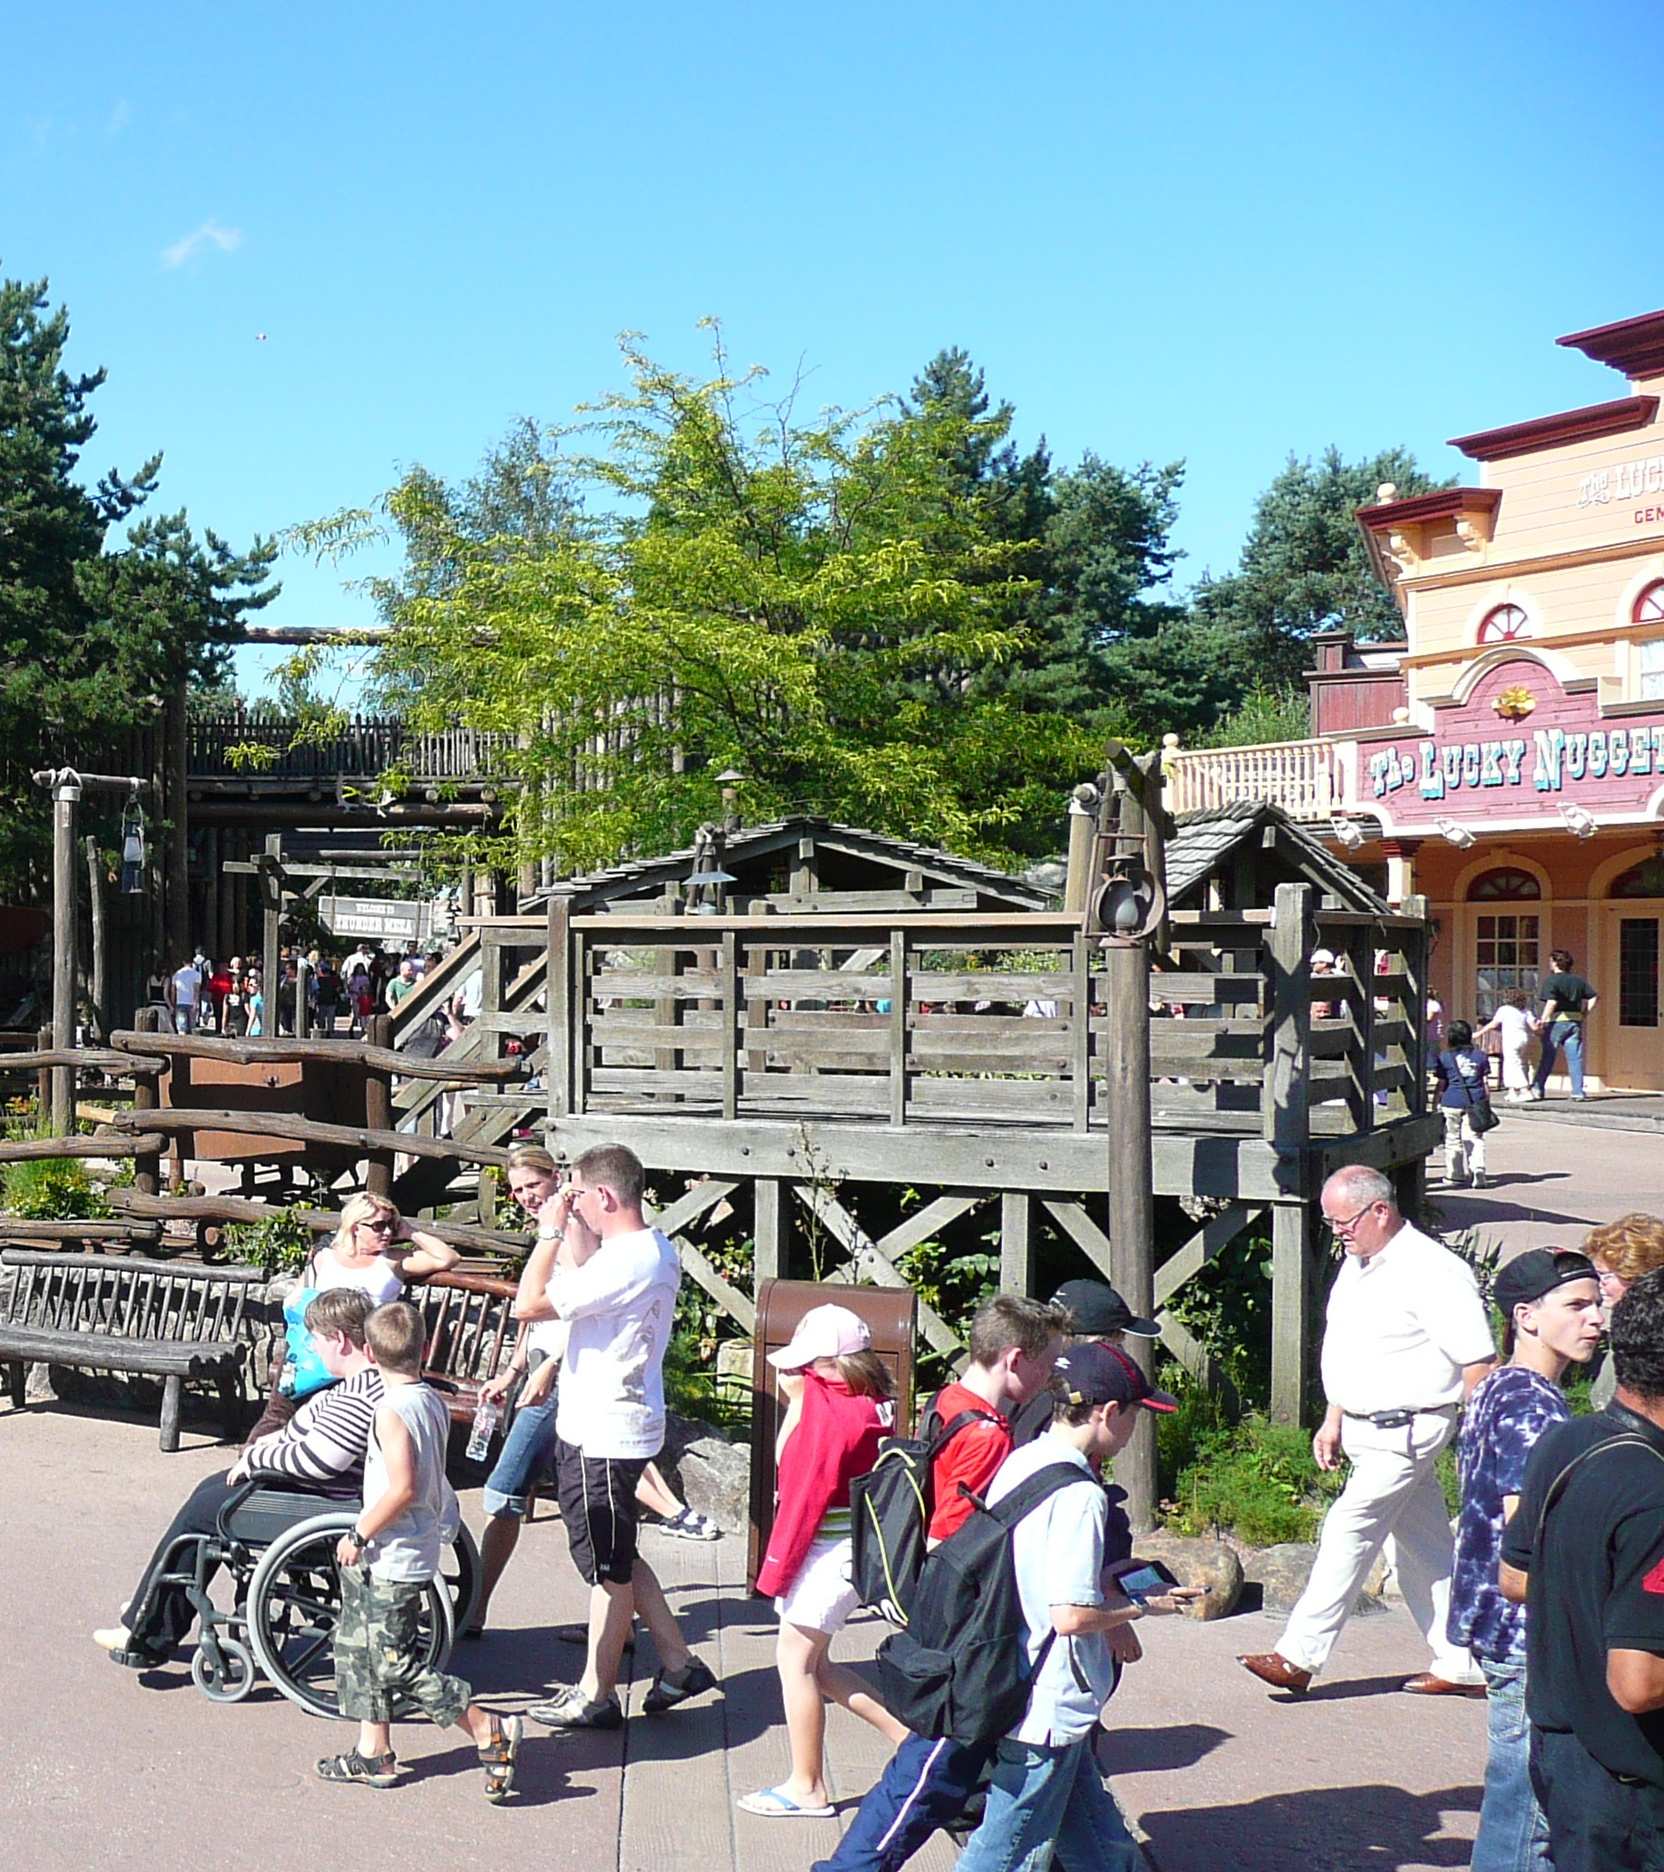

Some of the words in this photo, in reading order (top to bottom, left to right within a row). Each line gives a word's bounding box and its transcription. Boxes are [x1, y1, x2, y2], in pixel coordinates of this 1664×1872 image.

[1369, 746, 1415, 798] The
[1418, 738, 1526, 800] LUCKY
[335, 914, 383, 933] THUNDER
